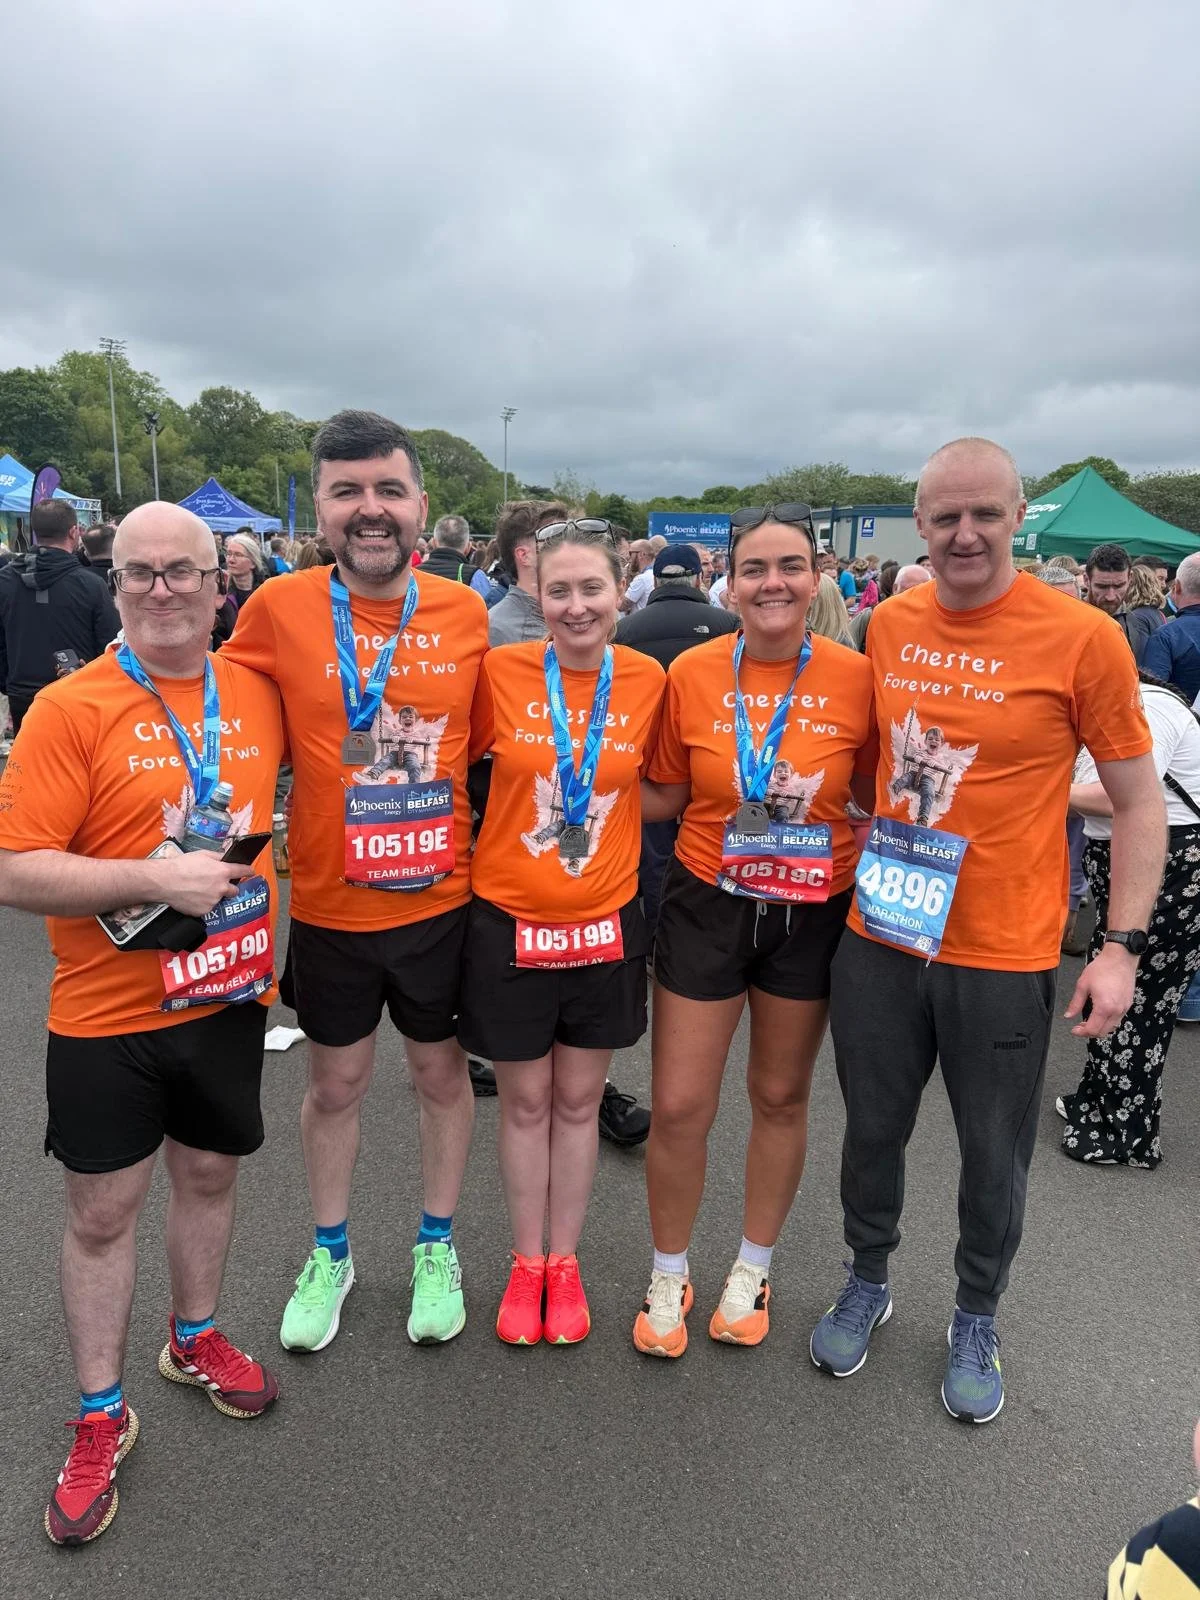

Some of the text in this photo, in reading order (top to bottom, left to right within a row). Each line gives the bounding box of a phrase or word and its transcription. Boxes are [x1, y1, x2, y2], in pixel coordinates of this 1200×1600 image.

[669, 525, 698, 534] Phoenix
[354, 632, 442, 650] heter
[325, 661, 412, 679] Feer
[417, 660, 457, 675] Two
[900, 643, 1004, 676] Chester
[883, 672, 1005, 703] Forever Two
[526, 701, 630, 728] Chser
[134, 717, 242, 742] Chser
[713, 718, 838, 736] Fovr Two
[515, 728, 635, 753] Foree Two
[222, 745, 260, 761] Two
[357, 798, 402, 812] Phoenix
[408, 794, 450, 809] BELFAST
[351, 826, 448, 860] 10519E
[735, 832, 777, 844] Phoenix
[783, 835, 828, 846] BELFAST
[913, 843, 959, 861] BELFAST
[367, 864, 437, 879] TEAM RELAY
[726, 862, 825, 887] 10519C
[770, 886, 805, 901] RELAY
[858, 861, 947, 917] 4896
[225, 892, 267, 916] BELFAST
[867, 904, 924, 930] MARATHON
[520, 920, 616, 951] 10519B
[166, 928, 269, 985] 10519D
[569, 956, 605, 968] RELAY
[226, 968, 257, 991] RELAY
